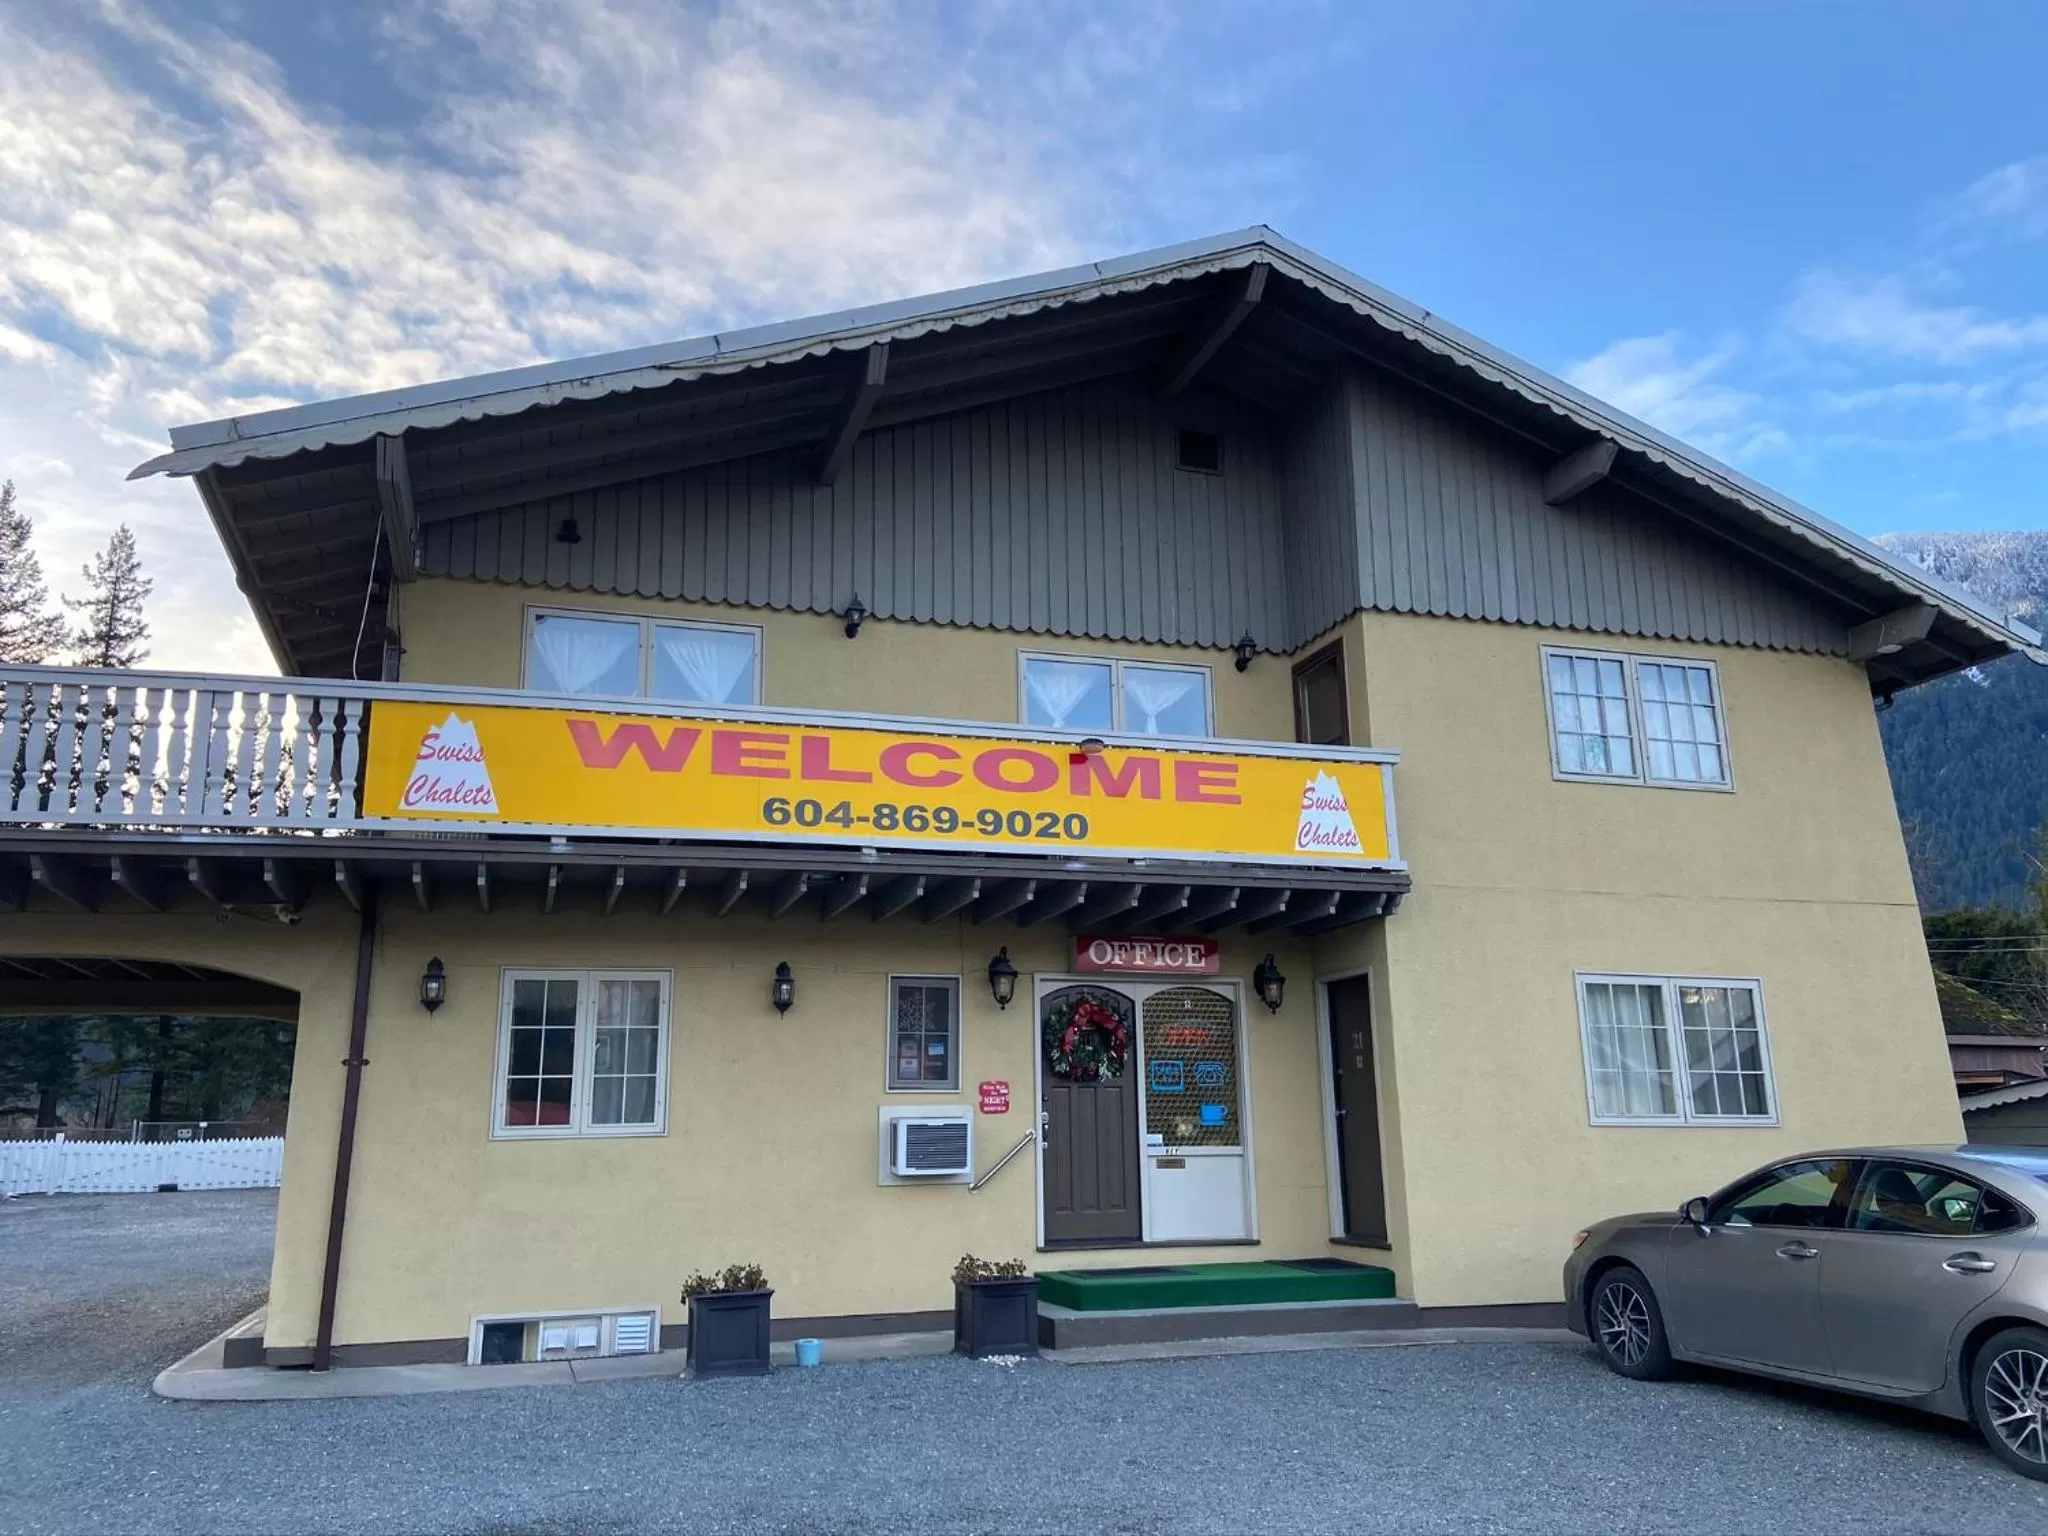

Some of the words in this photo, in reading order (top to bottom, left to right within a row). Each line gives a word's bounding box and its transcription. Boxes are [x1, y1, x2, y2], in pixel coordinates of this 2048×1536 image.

[416, 732, 486, 763] Swiss
[565, 718, 1242, 805] WELCOME
[404, 773, 494, 807] Chalets
[1301, 786, 1349, 812] Swiss
[762, 797, 1089, 841] 604-869-9020
[1298, 820, 1360, 848] Chalets
[1088, 939, 1206, 968] OFFICE
